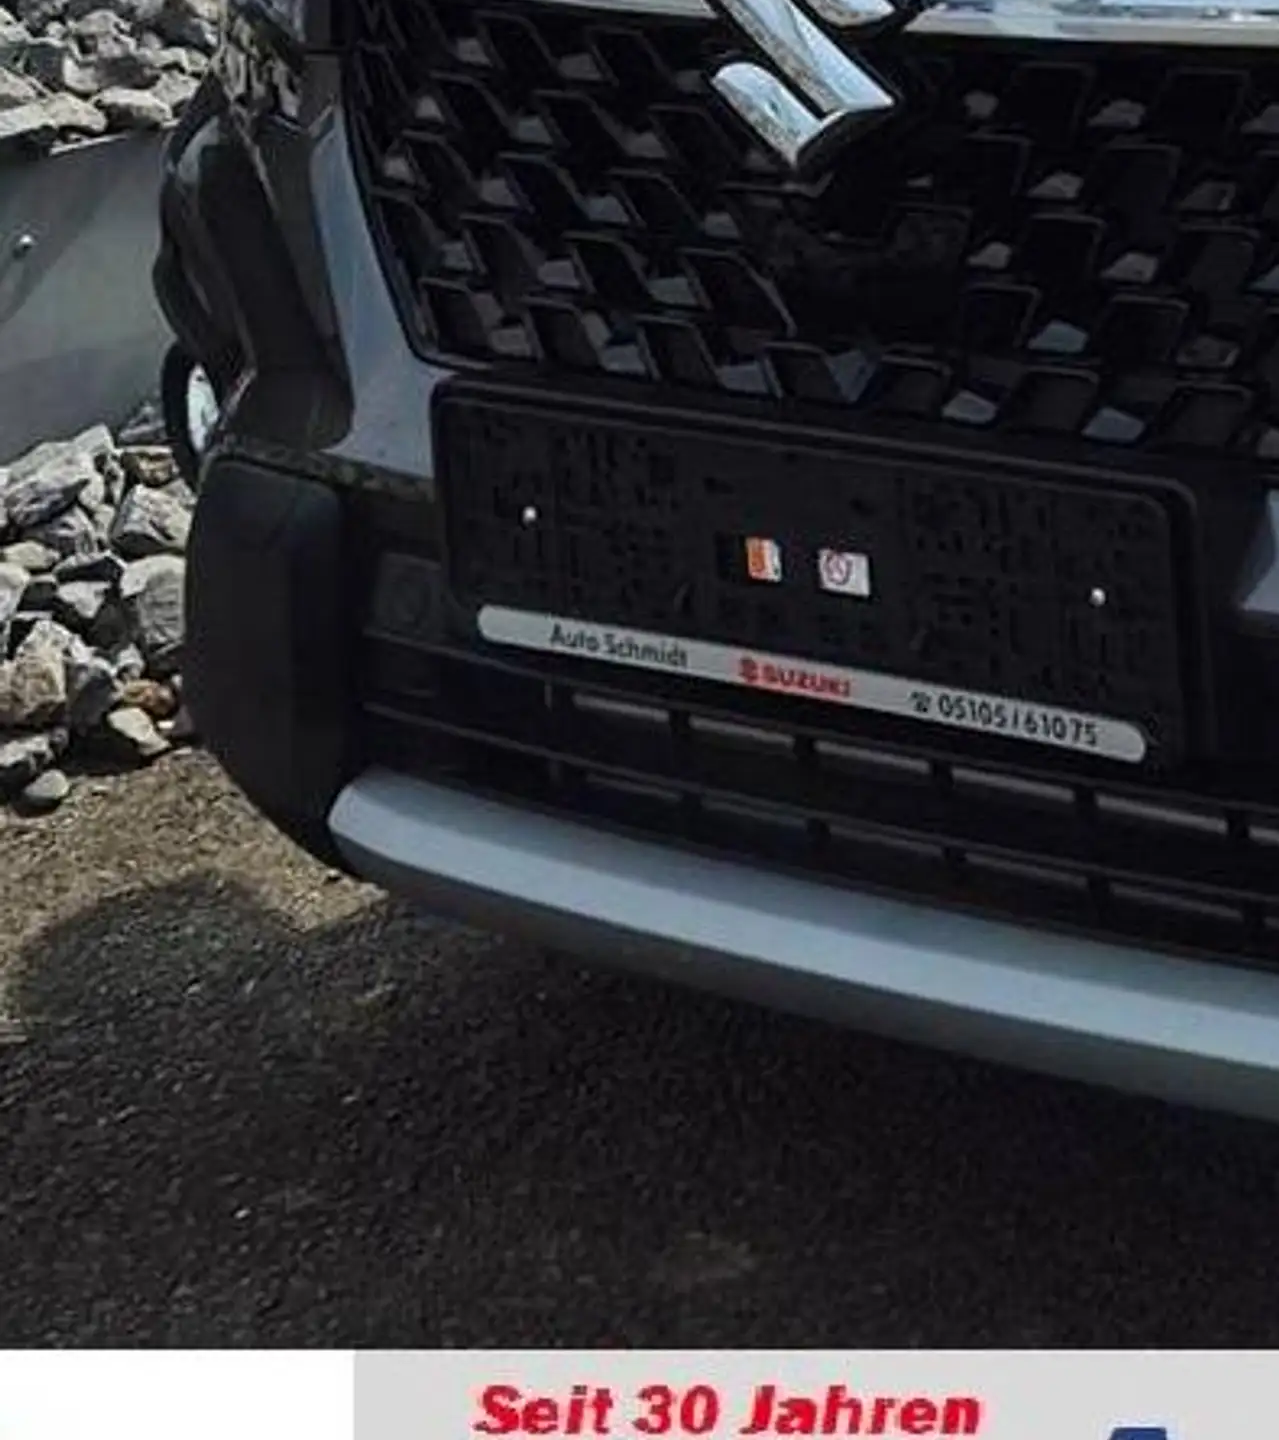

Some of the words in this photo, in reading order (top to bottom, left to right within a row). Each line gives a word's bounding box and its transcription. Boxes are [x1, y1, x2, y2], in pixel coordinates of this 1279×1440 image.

[549, 623, 599, 652] Auto
[600, 632, 689, 668] Schmidt
[763, 663, 851, 698] SUZUKI
